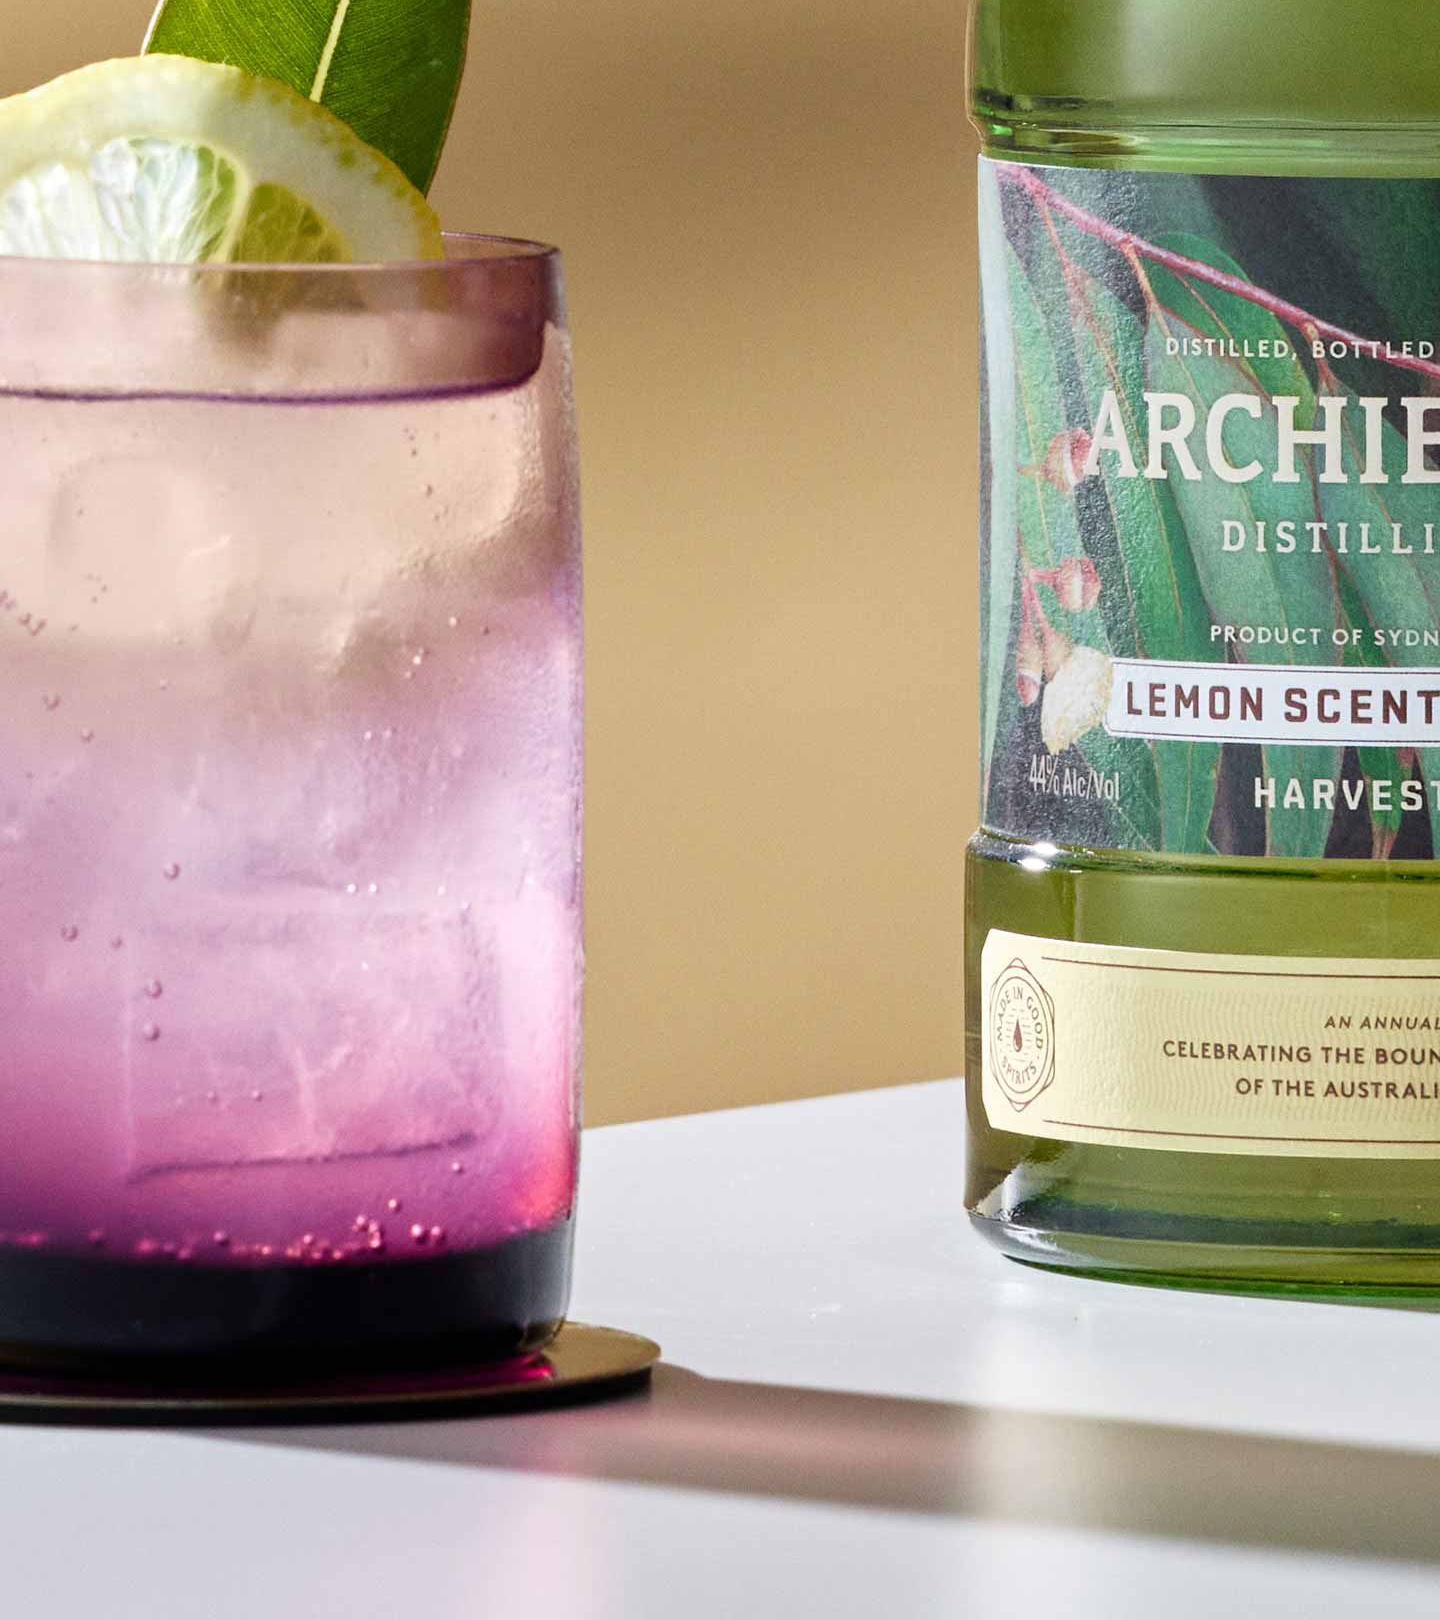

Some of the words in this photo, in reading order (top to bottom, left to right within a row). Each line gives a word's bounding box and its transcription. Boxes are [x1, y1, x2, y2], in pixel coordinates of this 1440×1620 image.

[1165, 337, 1297, 361] DISTILLED,
[1311, 340, 1434, 359] BOTTLED
[1209, 624, 1321, 646] PRODUCT
[1331, 628, 1363, 646] OF
[1126, 681, 1263, 721] LEMON
[1029, 753, 1060, 796] 44%
[1062, 766, 1121, 801] Alc/Vol
[1013, 986, 1024, 1001] IN
[1026, 996, 1044, 1050] GOOD
[1323, 1015, 1353, 1029] AN
[1162, 1040, 1312, 1063] CELEBRATING
[1321, 1046, 1366, 1064] THE
[1001, 1055, 1037, 1085] SPIRITS
[1235, 1077, 1264, 1095] OF
[1272, 1080, 1315, 1097] THE
